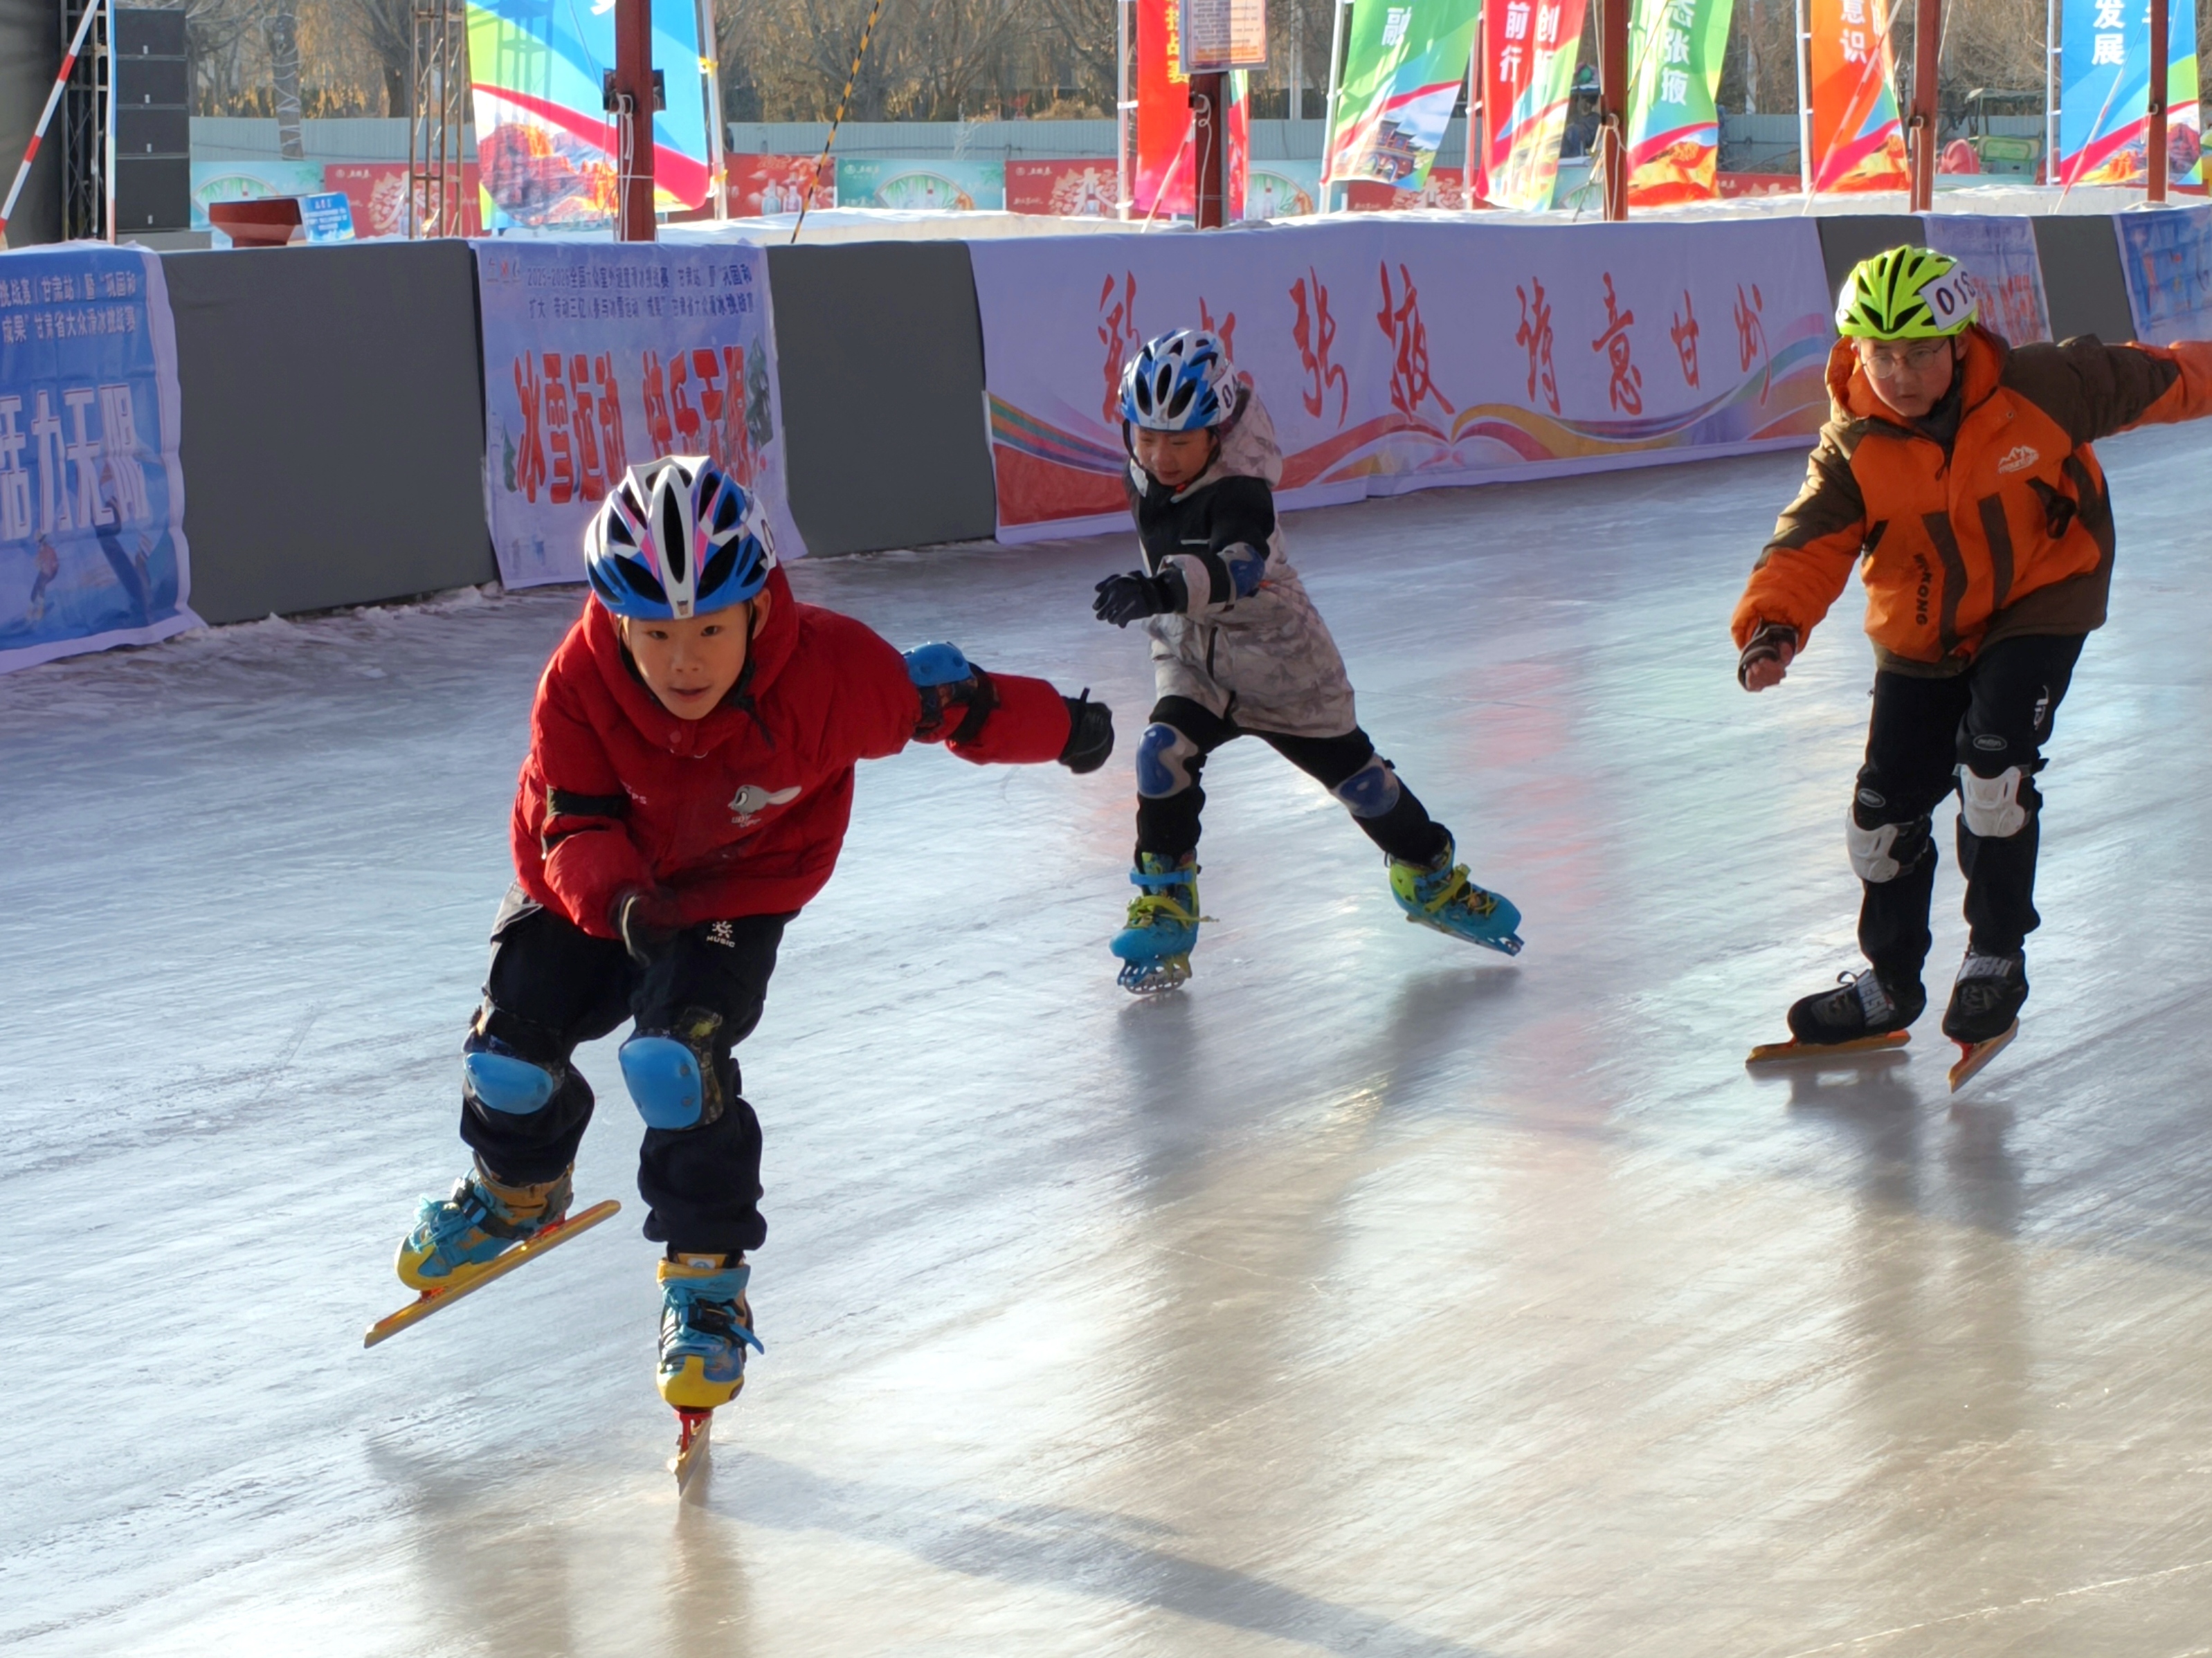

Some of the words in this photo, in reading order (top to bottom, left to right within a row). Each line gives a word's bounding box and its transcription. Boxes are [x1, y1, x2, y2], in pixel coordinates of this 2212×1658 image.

[1500, 0, 1531, 82] 前行
[1840, 0, 1867, 64] 意识
[2091, 0, 2125, 65] 发展
[514, 349, 628, 504] 冰雪运动
